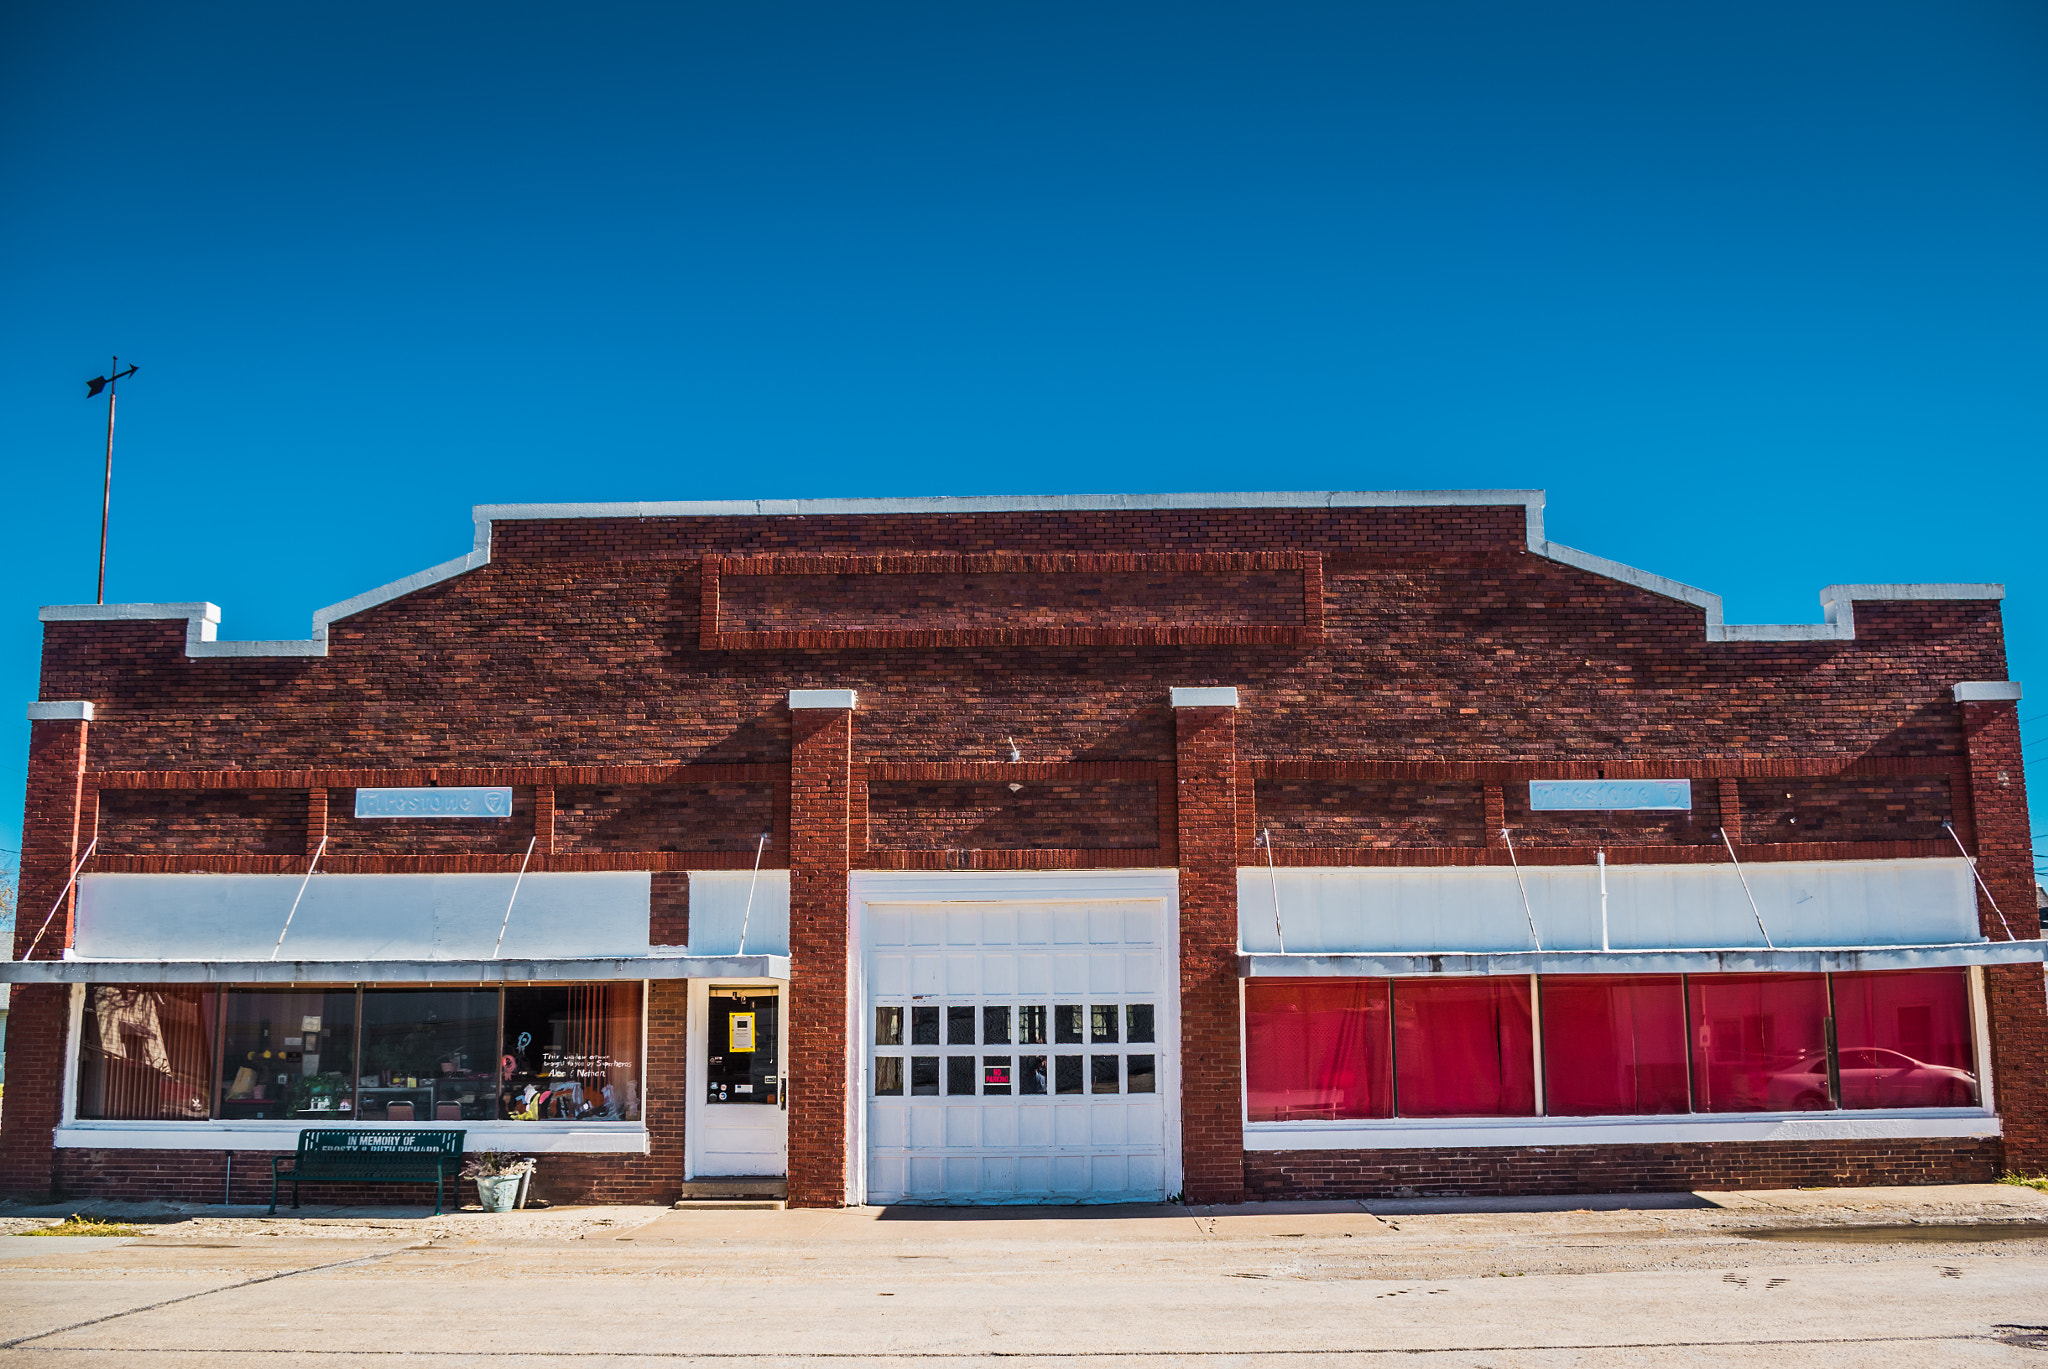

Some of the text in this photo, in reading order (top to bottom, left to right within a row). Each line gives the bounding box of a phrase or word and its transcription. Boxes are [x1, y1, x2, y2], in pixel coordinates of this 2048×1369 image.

[361, 794, 471, 814] Firestone
[1536, 785, 1649, 804] Firestone
[347, 1136, 416, 1146] IN MEMORY OF
